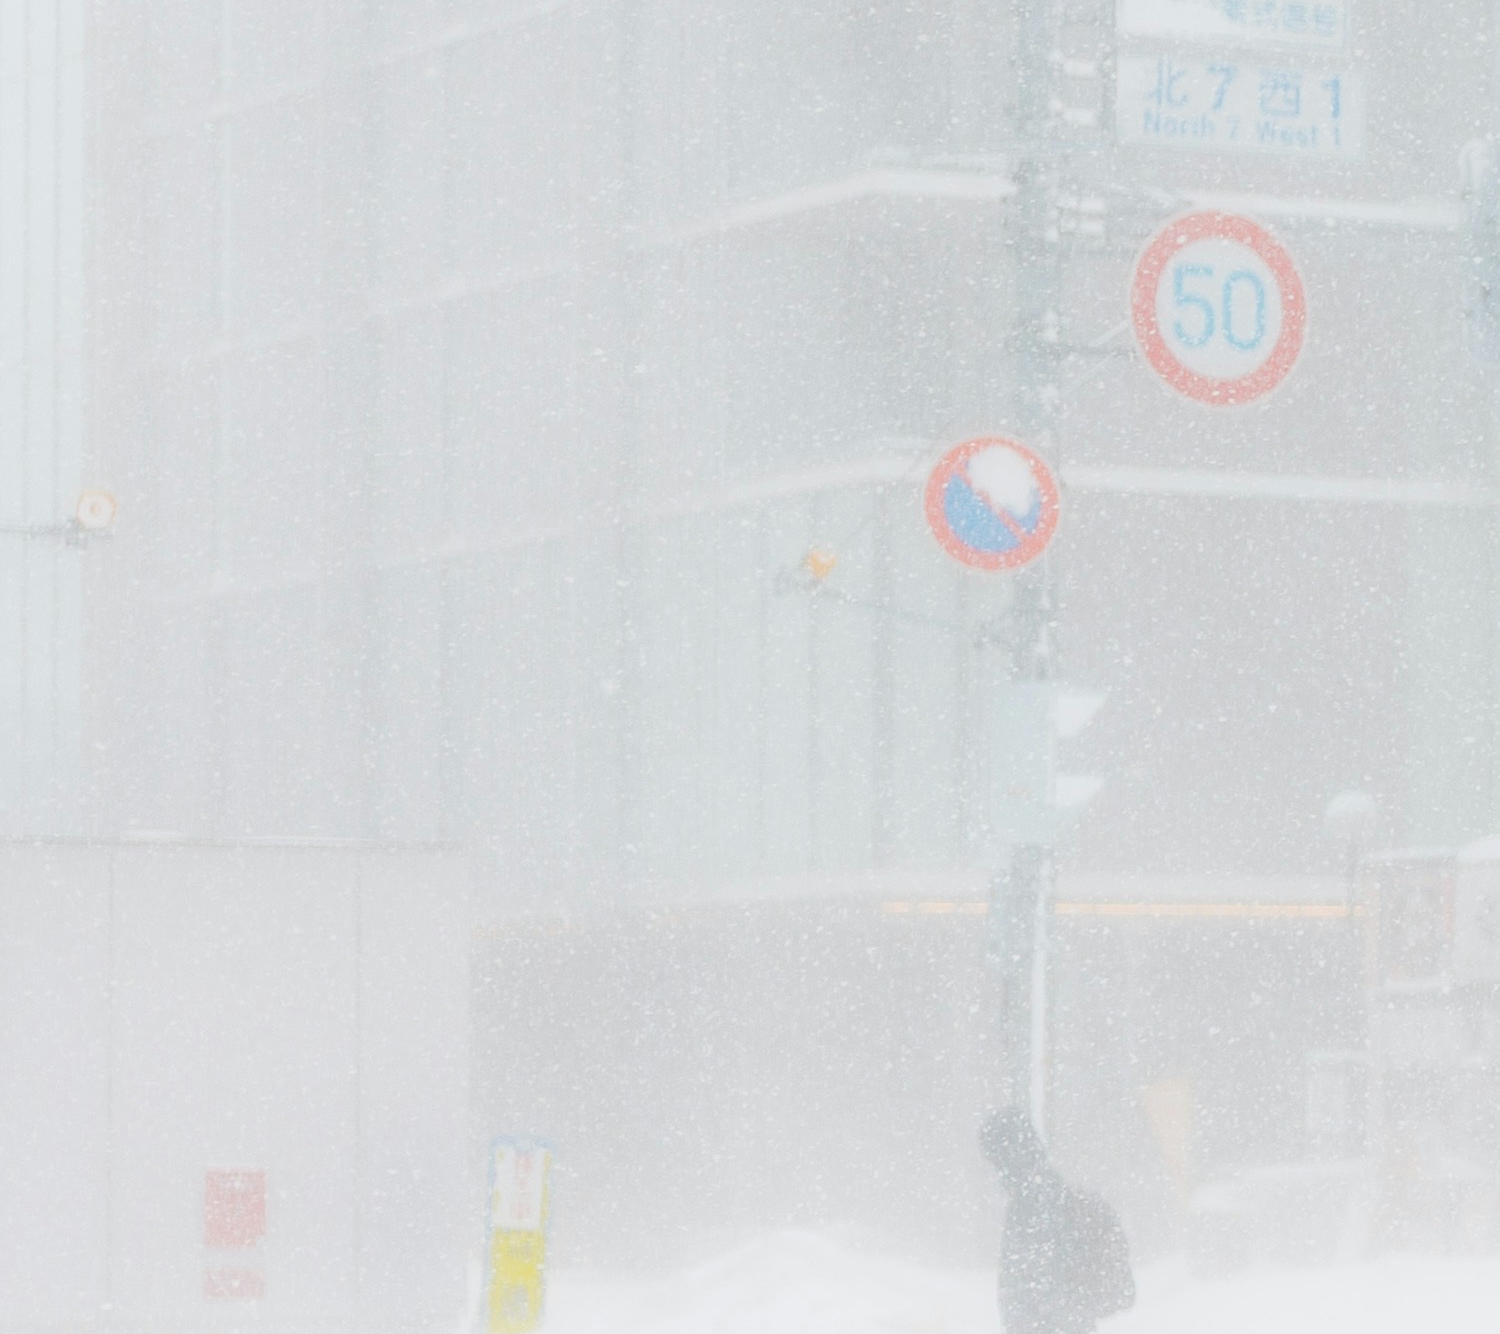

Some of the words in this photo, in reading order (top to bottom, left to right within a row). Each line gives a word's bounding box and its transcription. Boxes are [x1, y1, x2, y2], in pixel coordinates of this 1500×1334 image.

[1143, 108, 1216, 138] North
[1226, 115, 1242, 140] 7
[1256, 120, 1317, 148] West
[1172, 262, 1266, 352] 50
